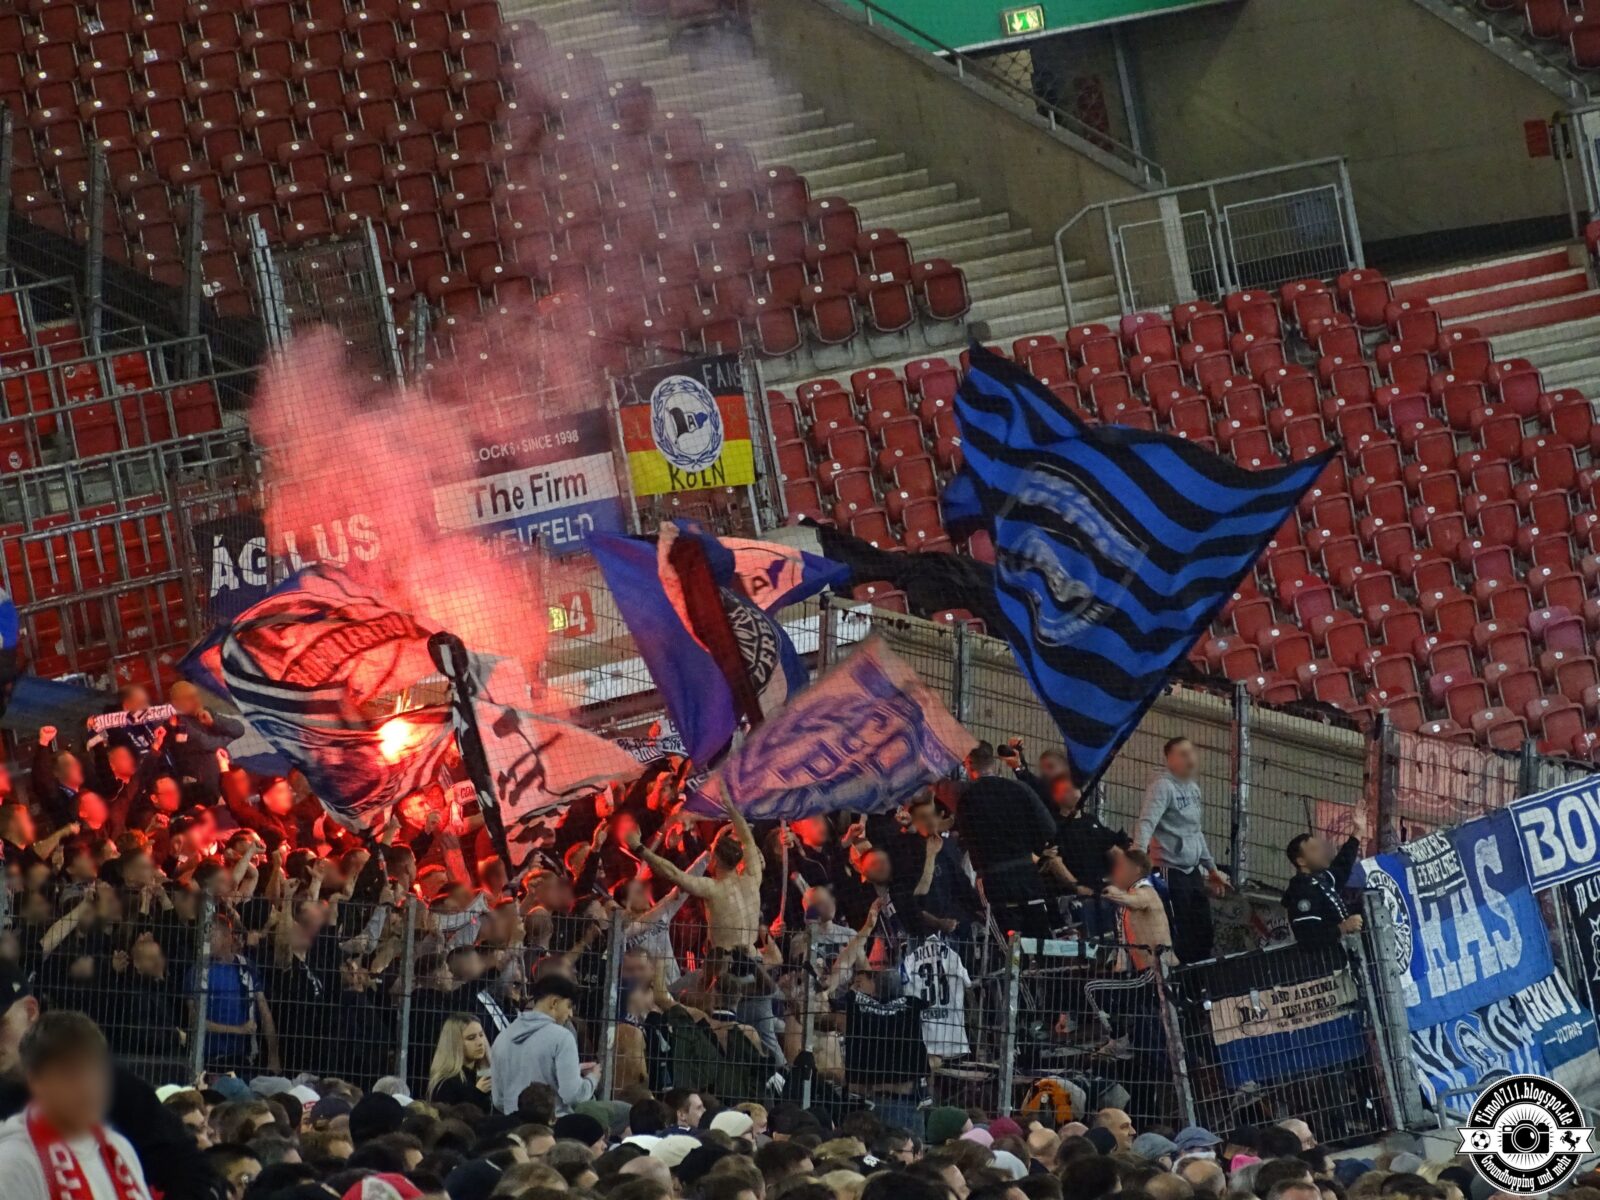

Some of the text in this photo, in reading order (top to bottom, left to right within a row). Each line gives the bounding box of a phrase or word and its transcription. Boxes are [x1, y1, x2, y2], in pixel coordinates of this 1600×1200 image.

[521, 434, 553, 453] SINCE
[555, 429, 580, 446] 1998
[468, 471, 588, 518] The Firm
[569, 595, 587, 632] 4
